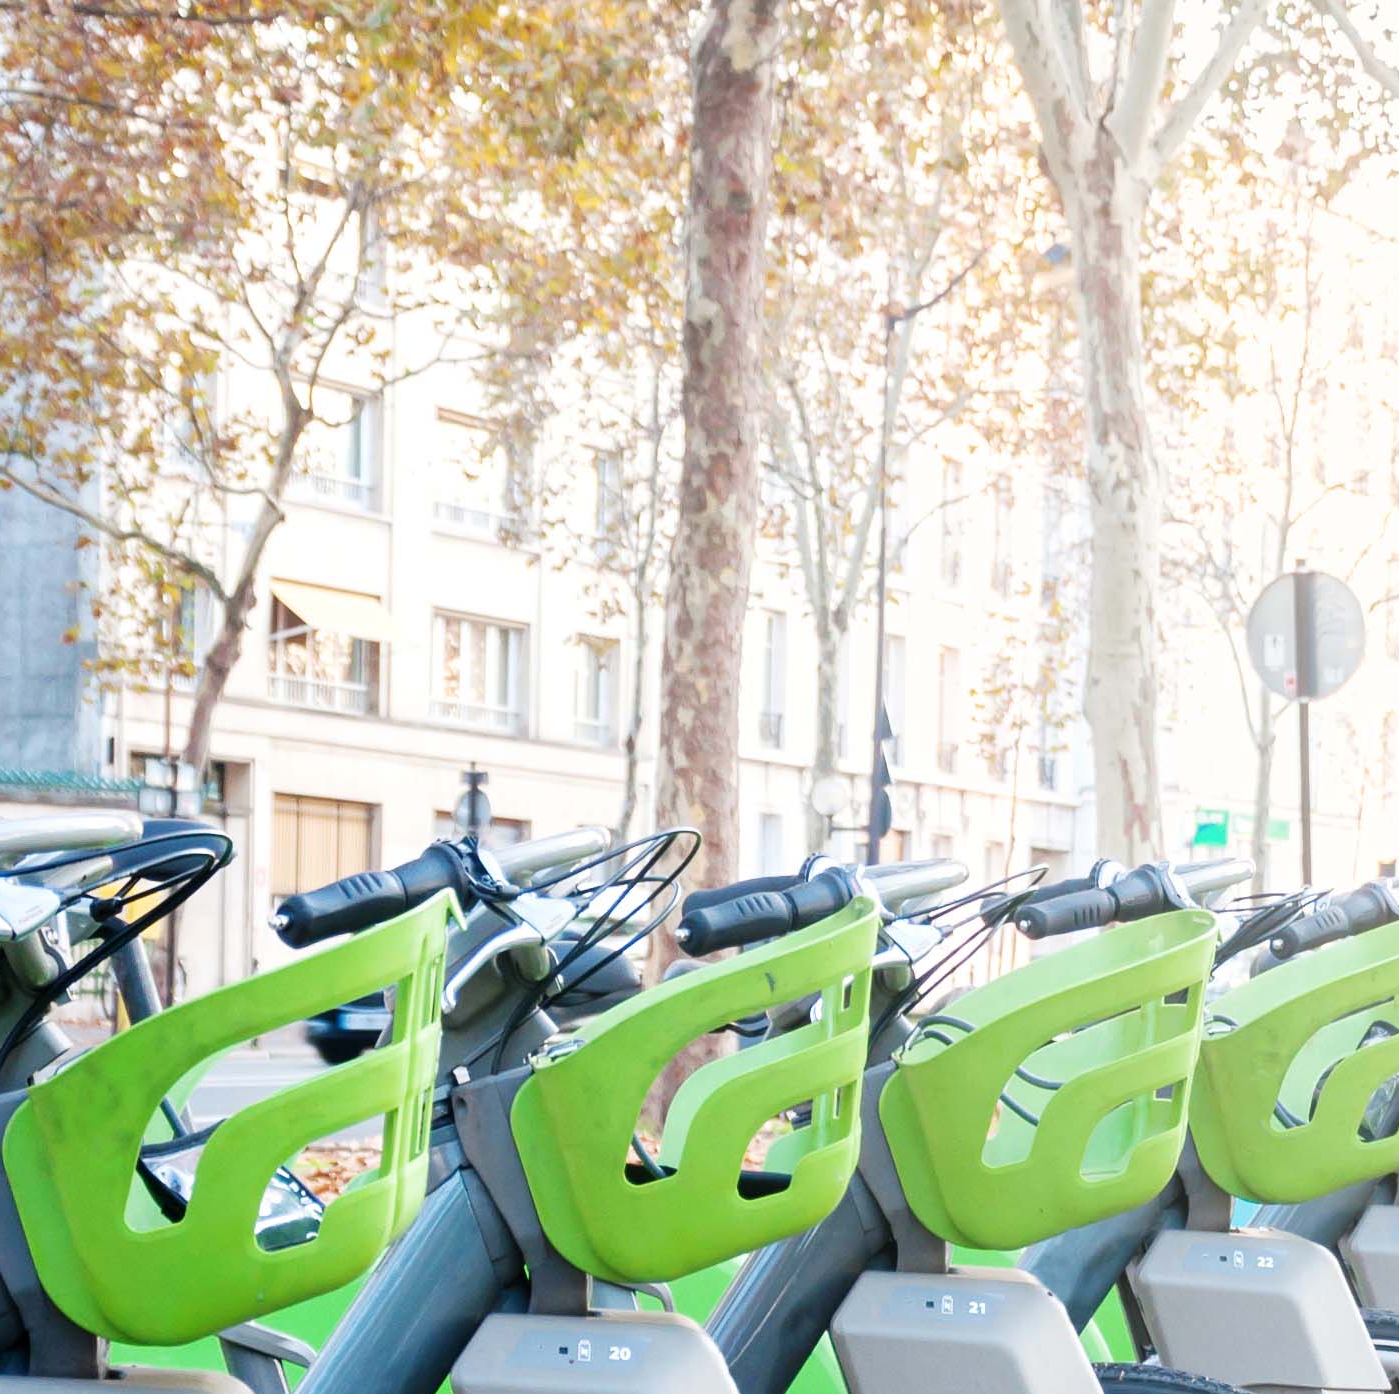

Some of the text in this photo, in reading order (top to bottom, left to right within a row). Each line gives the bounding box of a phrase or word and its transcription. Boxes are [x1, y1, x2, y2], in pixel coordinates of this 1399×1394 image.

[1256, 1256, 1274, 1269] 22
[968, 1301, 986, 1315] 21
[608, 1345, 631, 1361] 20
